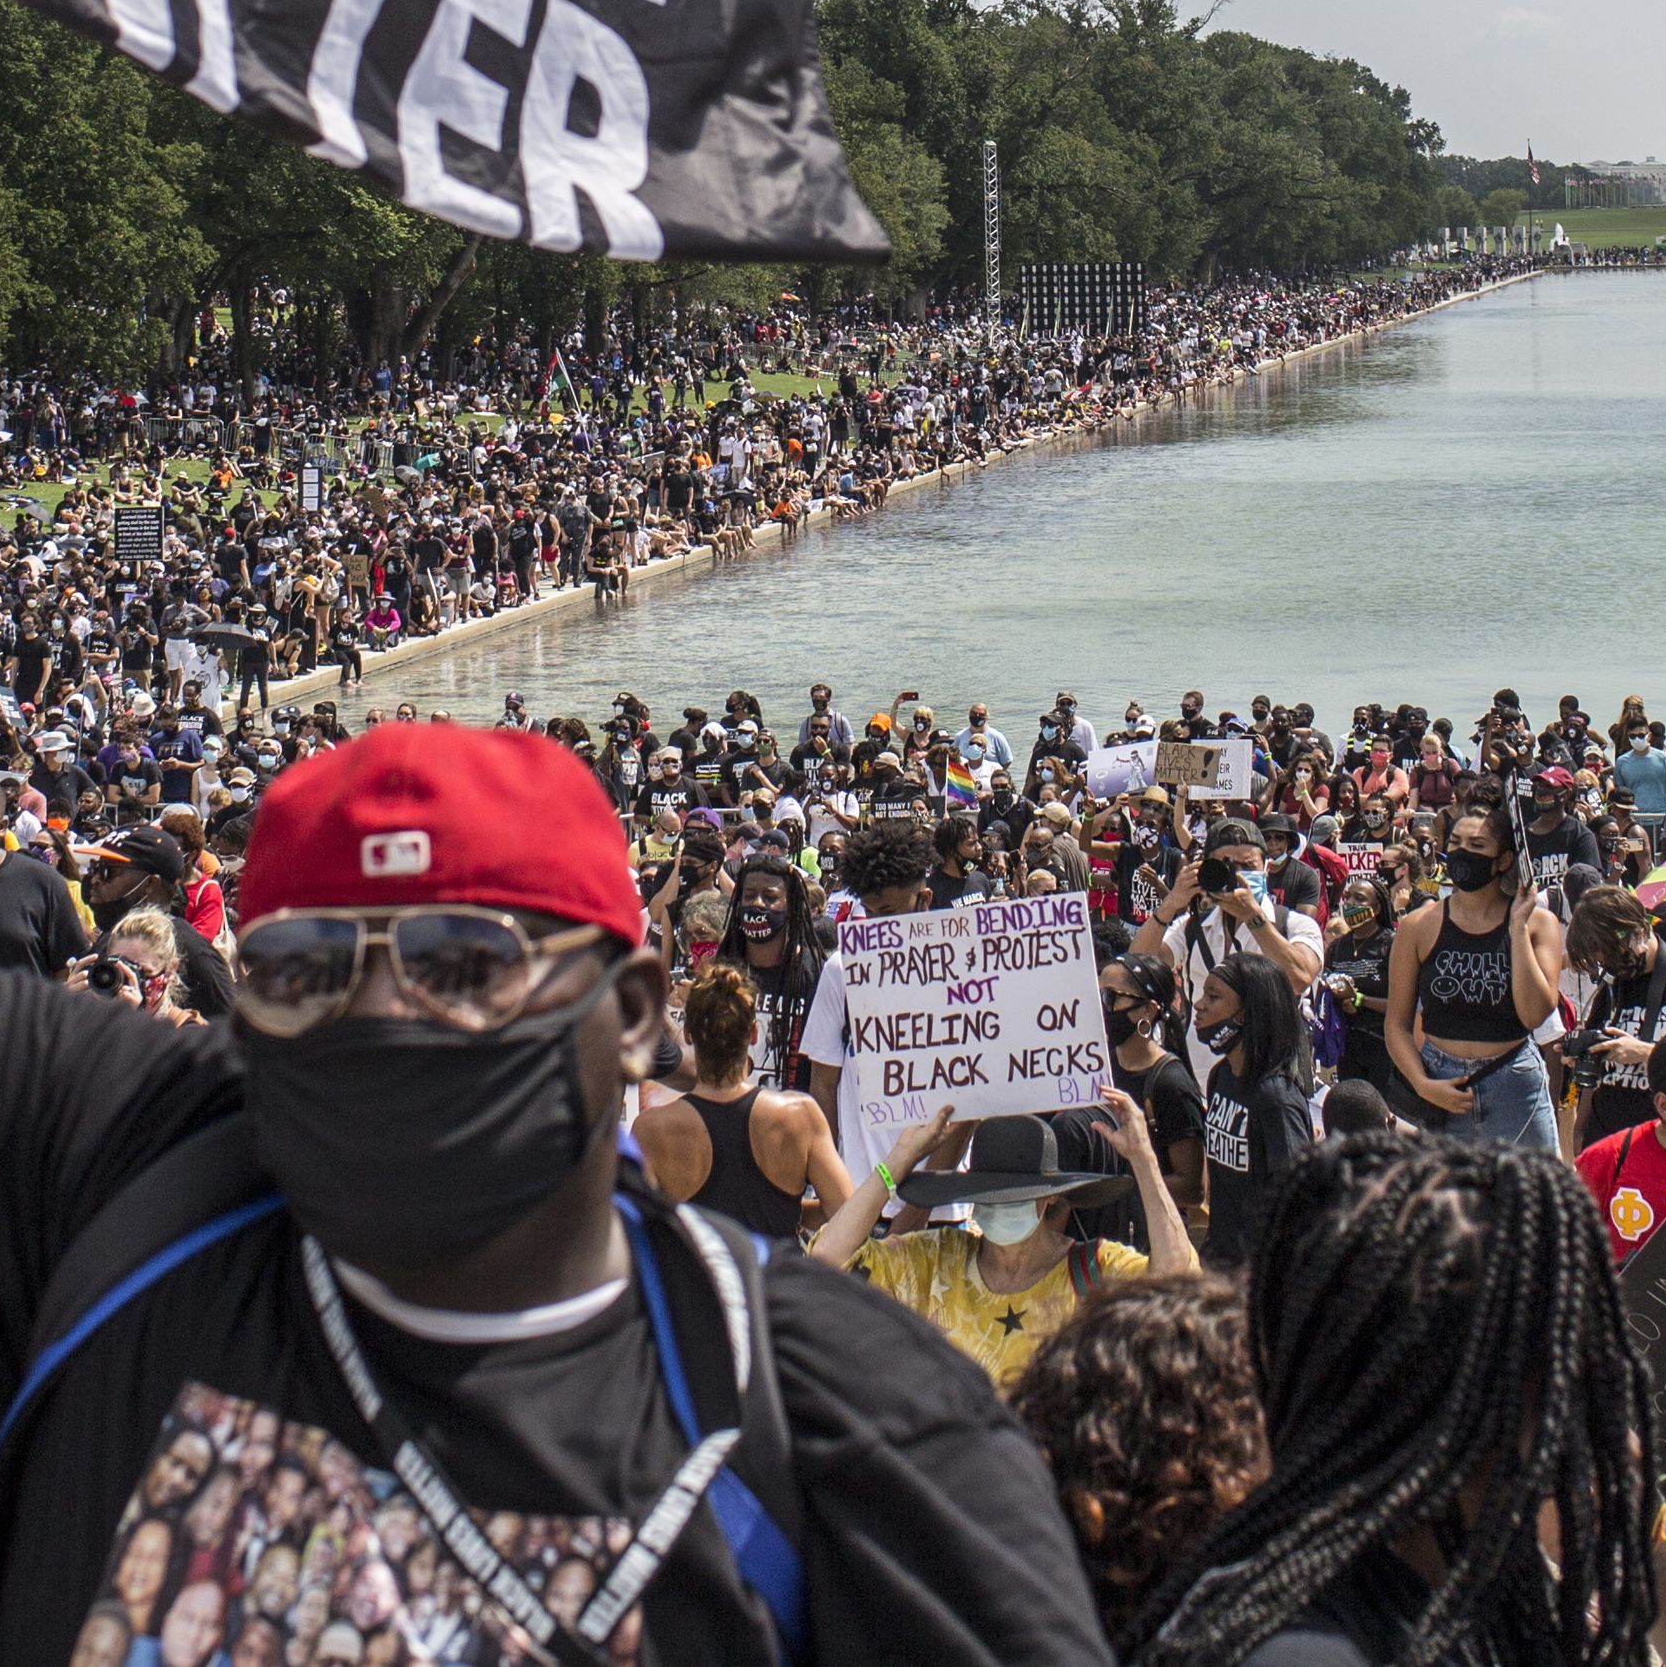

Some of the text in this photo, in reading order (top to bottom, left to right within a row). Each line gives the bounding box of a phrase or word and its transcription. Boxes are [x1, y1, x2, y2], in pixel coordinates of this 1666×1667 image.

[1157, 755, 1191, 771] LIVES
[1158, 743, 1197, 760] BLACK
[1220, 748, 1229, 758] AY
[1155, 767, 1198, 782] MATTER
[651, 793, 688, 805] BLACK
[888, 802, 906, 810] MANY
[648, 850, 671, 860] blac
[840, 898, 1084, 954] KNEES ARE FOR BENDING
[846, 962, 872, 987] IN
[878, 943, 959, 988] PRAYER
[982, 927, 1086, 973] PROTEST
[1435, 950, 1512, 979] CHILL
[947, 976, 999, 1006] NOT
[855, 999, 1080, 1054] KNEELING ON
[883, 1042, 1105, 1097] BLACK NECKS
[1206, 1137, 1248, 1171] EATHE
